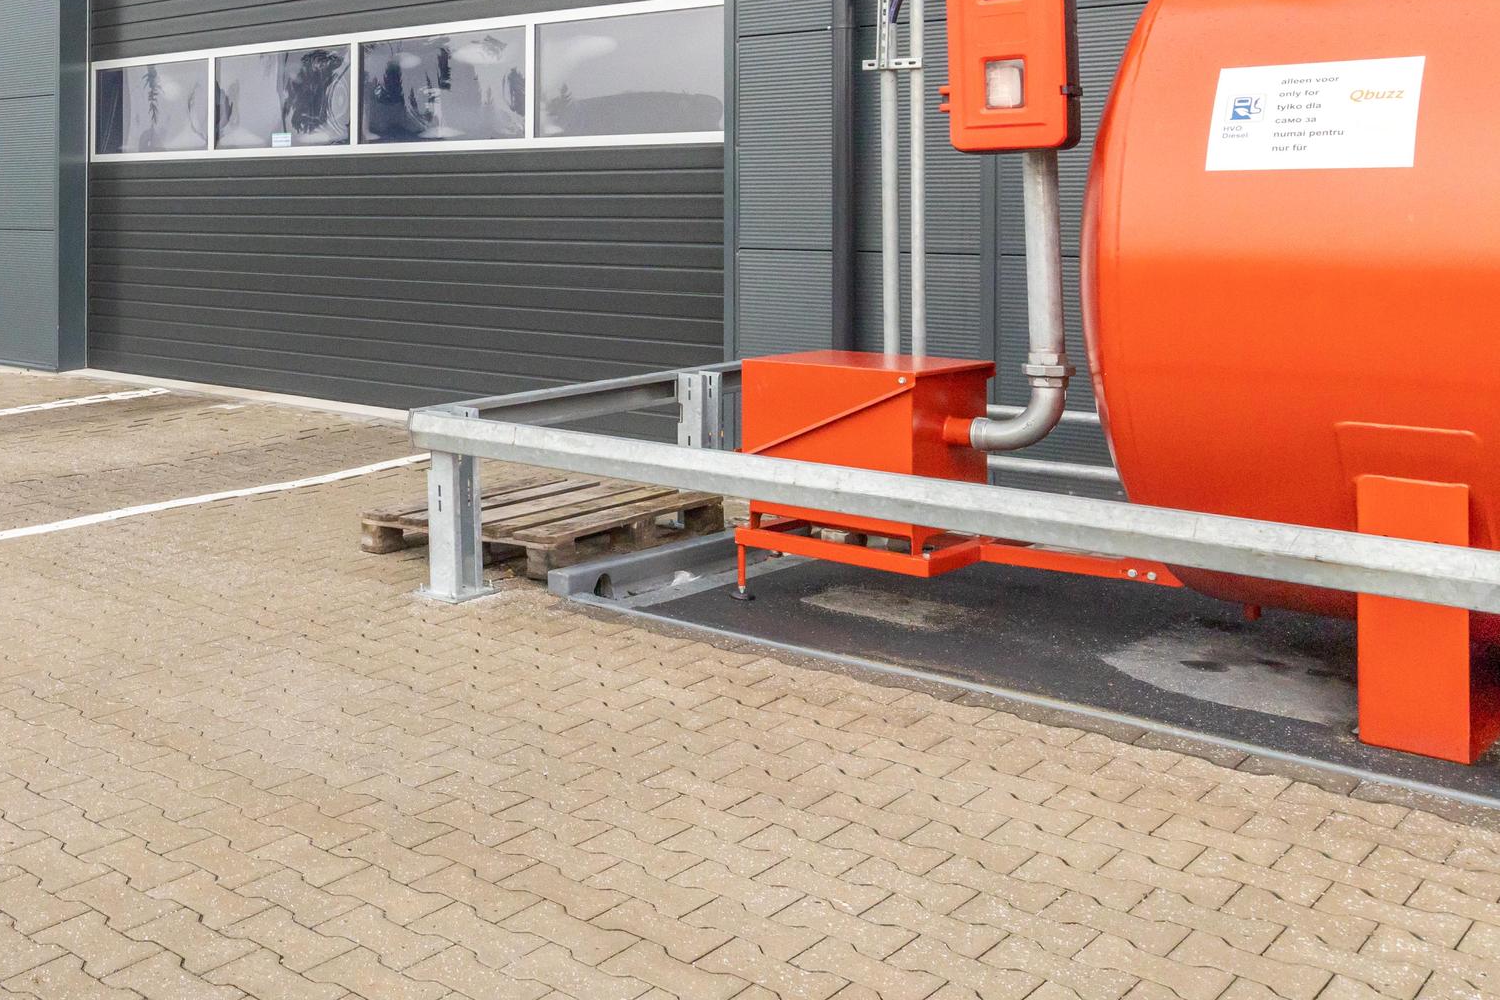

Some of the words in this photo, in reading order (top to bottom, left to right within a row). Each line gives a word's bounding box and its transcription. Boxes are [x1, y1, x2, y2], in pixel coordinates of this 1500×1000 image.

[1281, 77, 1312, 85] alleen
[1278, 90, 1301, 98] only
[1349, 89, 1405, 103] Qbuzz
[1276, 103, 1303, 112] tylko
[1273, 130, 1306, 138] numai
[1308, 129, 1344, 138] pentru
[1292, 143, 1308, 151] für
